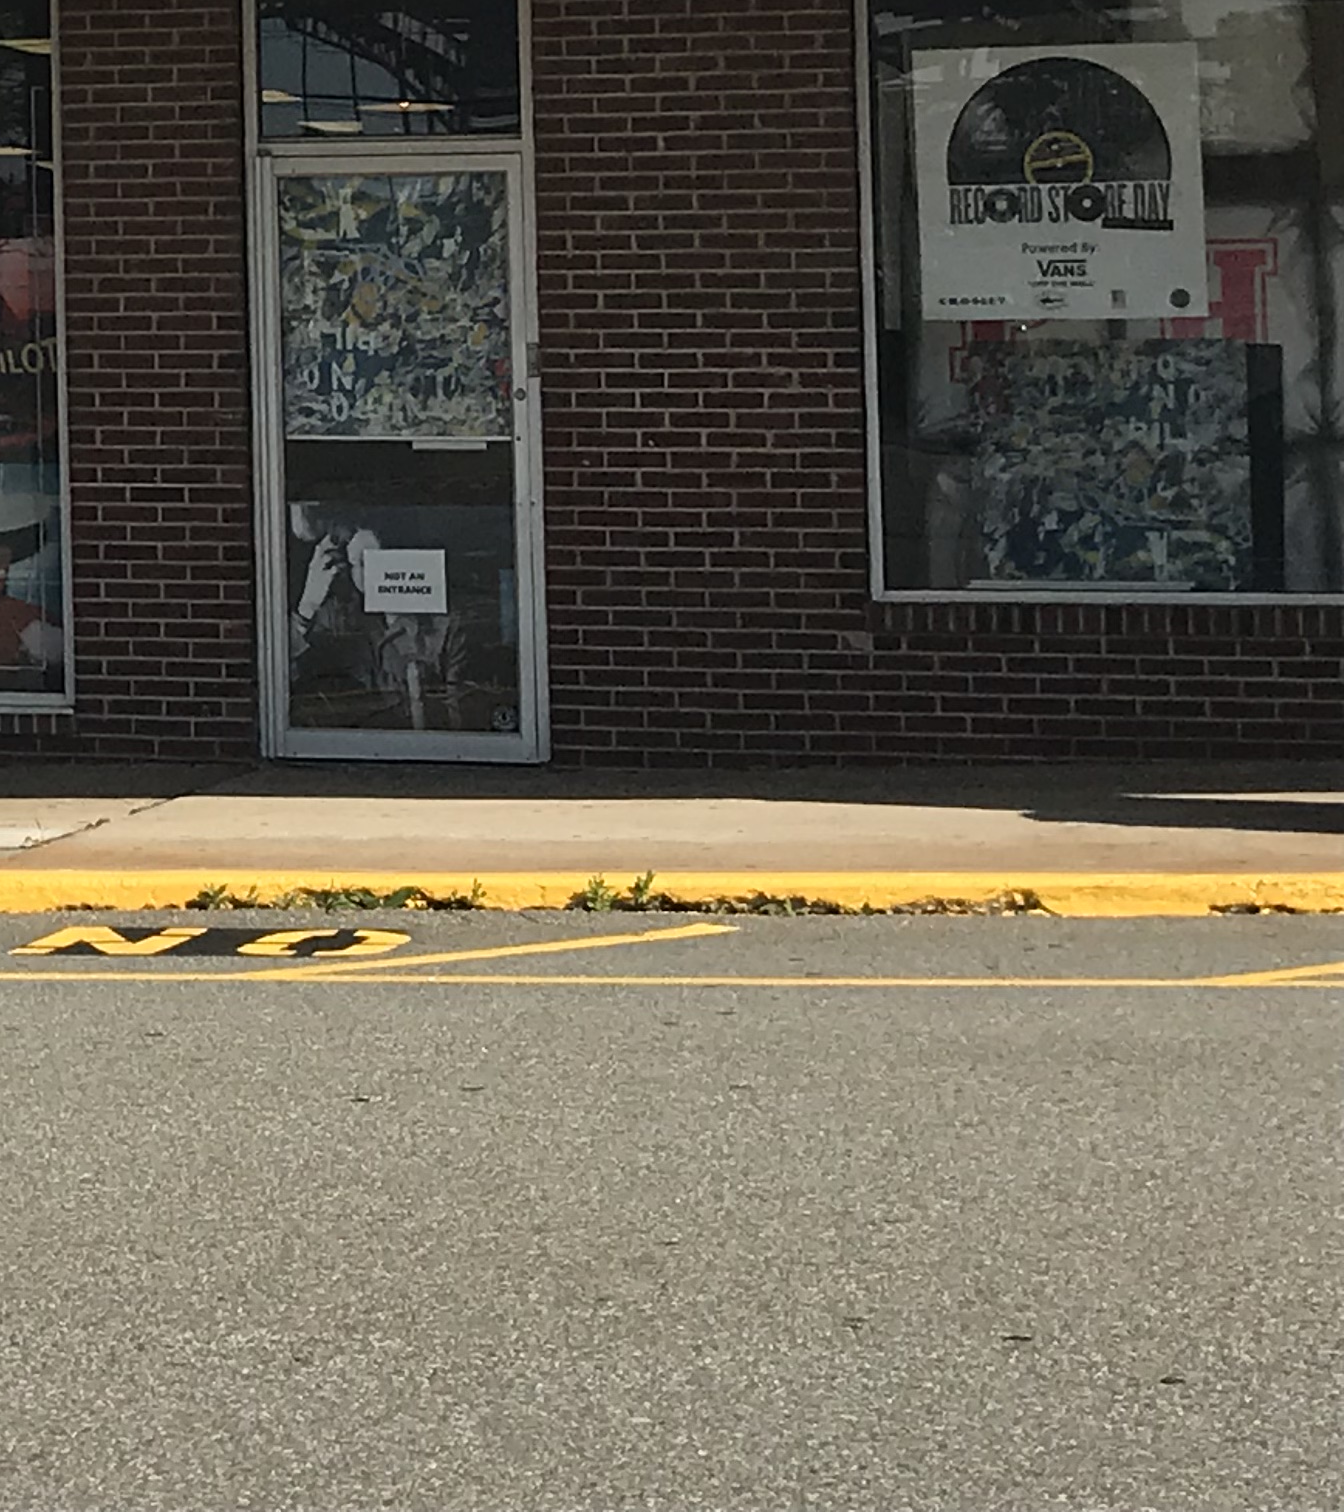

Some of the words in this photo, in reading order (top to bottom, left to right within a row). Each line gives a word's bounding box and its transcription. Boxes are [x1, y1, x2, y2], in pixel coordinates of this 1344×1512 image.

[948, 186, 1043, 224] RECORD
[1048, 183, 1128, 224] STORE
[1133, 182, 1171, 221] DAY
[1021, 242, 1078, 254] Powered
[1036, 259, 1088, 277] VANS
[383, 572, 406, 581] NOT
[409, 572, 425, 581] AN
[377, 585, 432, 595] ENTRANCE
[8, 925, 414, 958] NO
